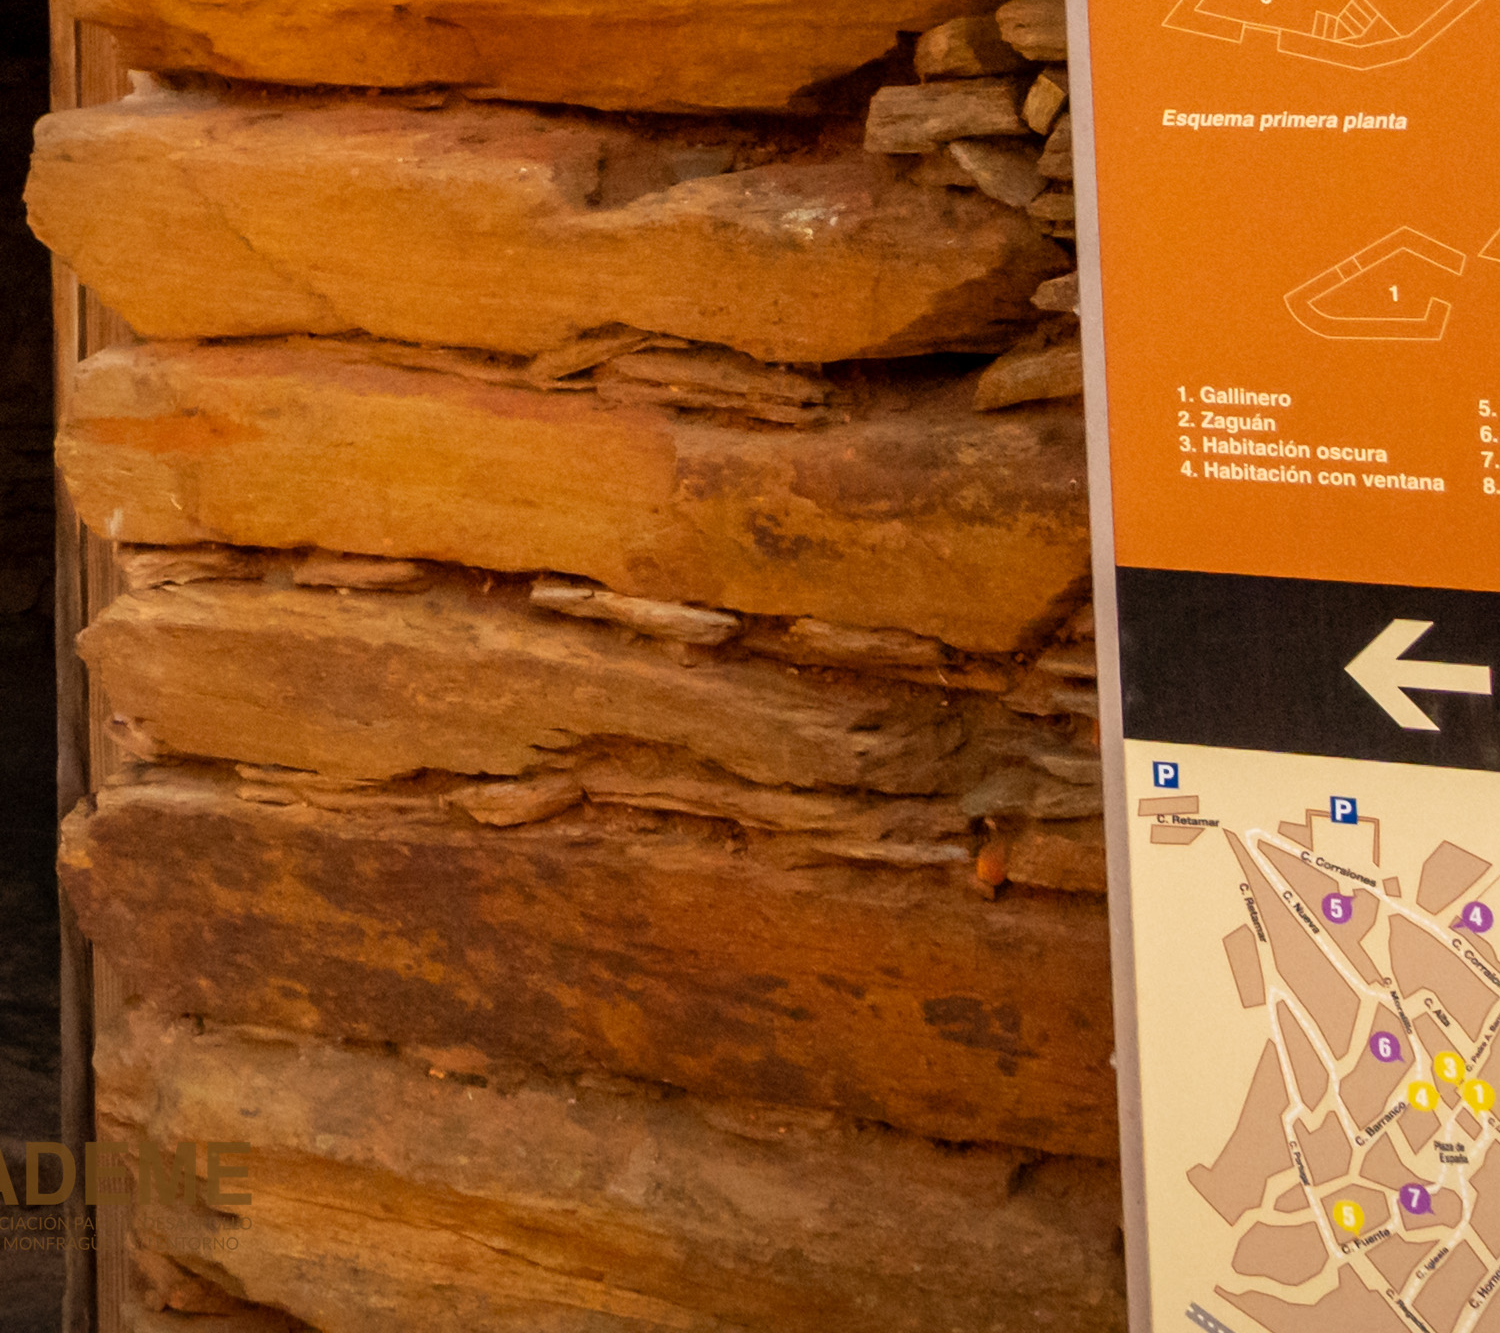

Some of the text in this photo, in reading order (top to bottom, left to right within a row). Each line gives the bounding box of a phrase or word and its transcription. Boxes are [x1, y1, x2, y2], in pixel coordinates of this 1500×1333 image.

[1163, 110, 1407, 132] Esquema primera planta
[1390, 286, 1398, 301] 1
[1178, 386, 1291, 407] 1. Gallinero
[1479, 400, 1496, 417] 5.
[1178, 411, 1275, 433] 2. Zaguán
[1480, 426, 1498, 442] 6.
[1180, 436, 1387, 462] 3. Habitación oscura
[1481, 451, 1499, 468] 7.
[1181, 461, 1444, 491] 4. Habitación con ventana
[1484, 477, 1500, 494] 8.
[1158, 764, 1174, 785] P
[1335, 800, 1352, 822] P
[1172, 815, 1220, 827] Retamar
[1315, 857, 1376, 887] Corralones
[1293, 902, 1320, 934] Nueva
[1331, 899, 1342, 918] 5
[1470, 907, 1482, 925] 4
[1379, 1038, 1391, 1057] 6
[1416, 1089, 1428, 1107] 4
[1474, 1084, 1483, 1103] 1
[1365, 1101, 1406, 1137] Barranco
[1409, 1188, 1420, 1207] 7
[1343, 1206, 1355, 1226] 5
